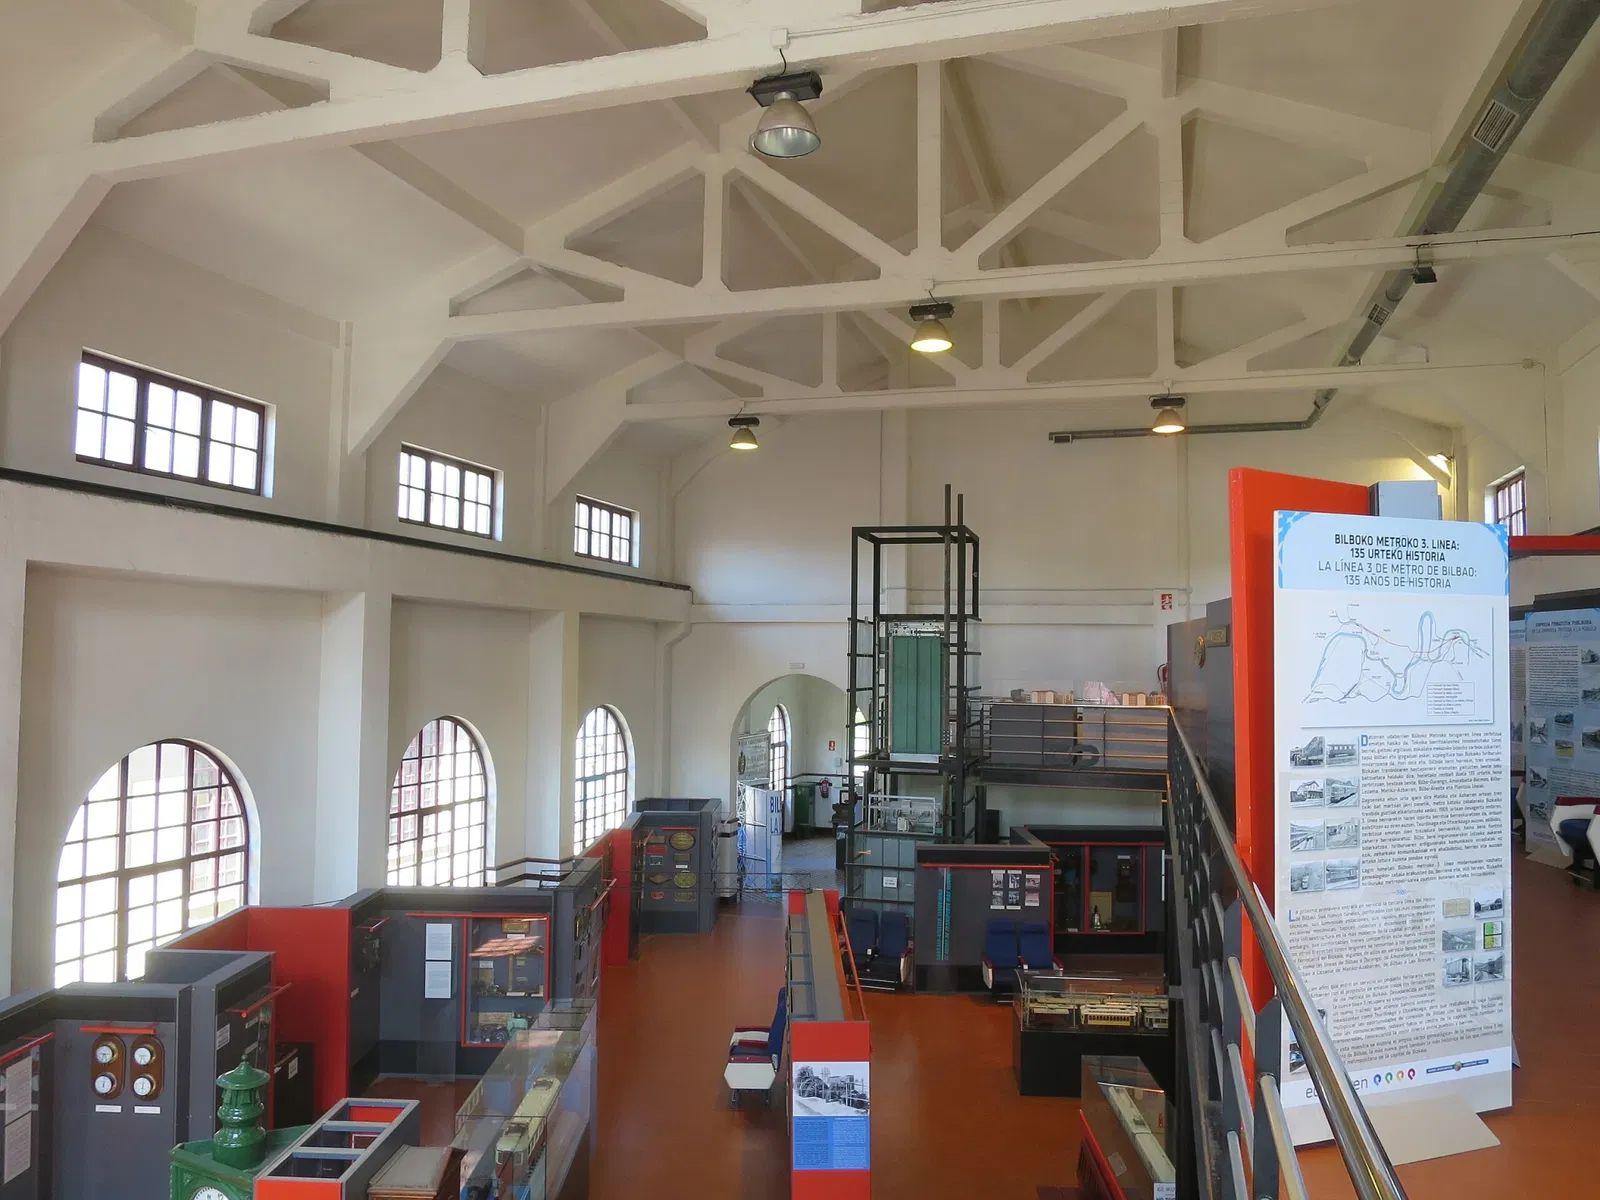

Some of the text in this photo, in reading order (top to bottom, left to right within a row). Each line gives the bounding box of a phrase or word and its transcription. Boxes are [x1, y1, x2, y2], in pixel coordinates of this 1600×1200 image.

[1335, 534, 1460, 550] BILBOKO METROKO 3. LINEA:
[1350, 549, 1446, 562] 135 URTEKO HISTORIA
[1318, 559, 1477, 577] LA LÍNEA 3 DE METRO DE BILBAO:
[1344, 573, 1452, 589] 135 AÑOS DE HISTORIA
[770, 796, 782, 813] BIL
